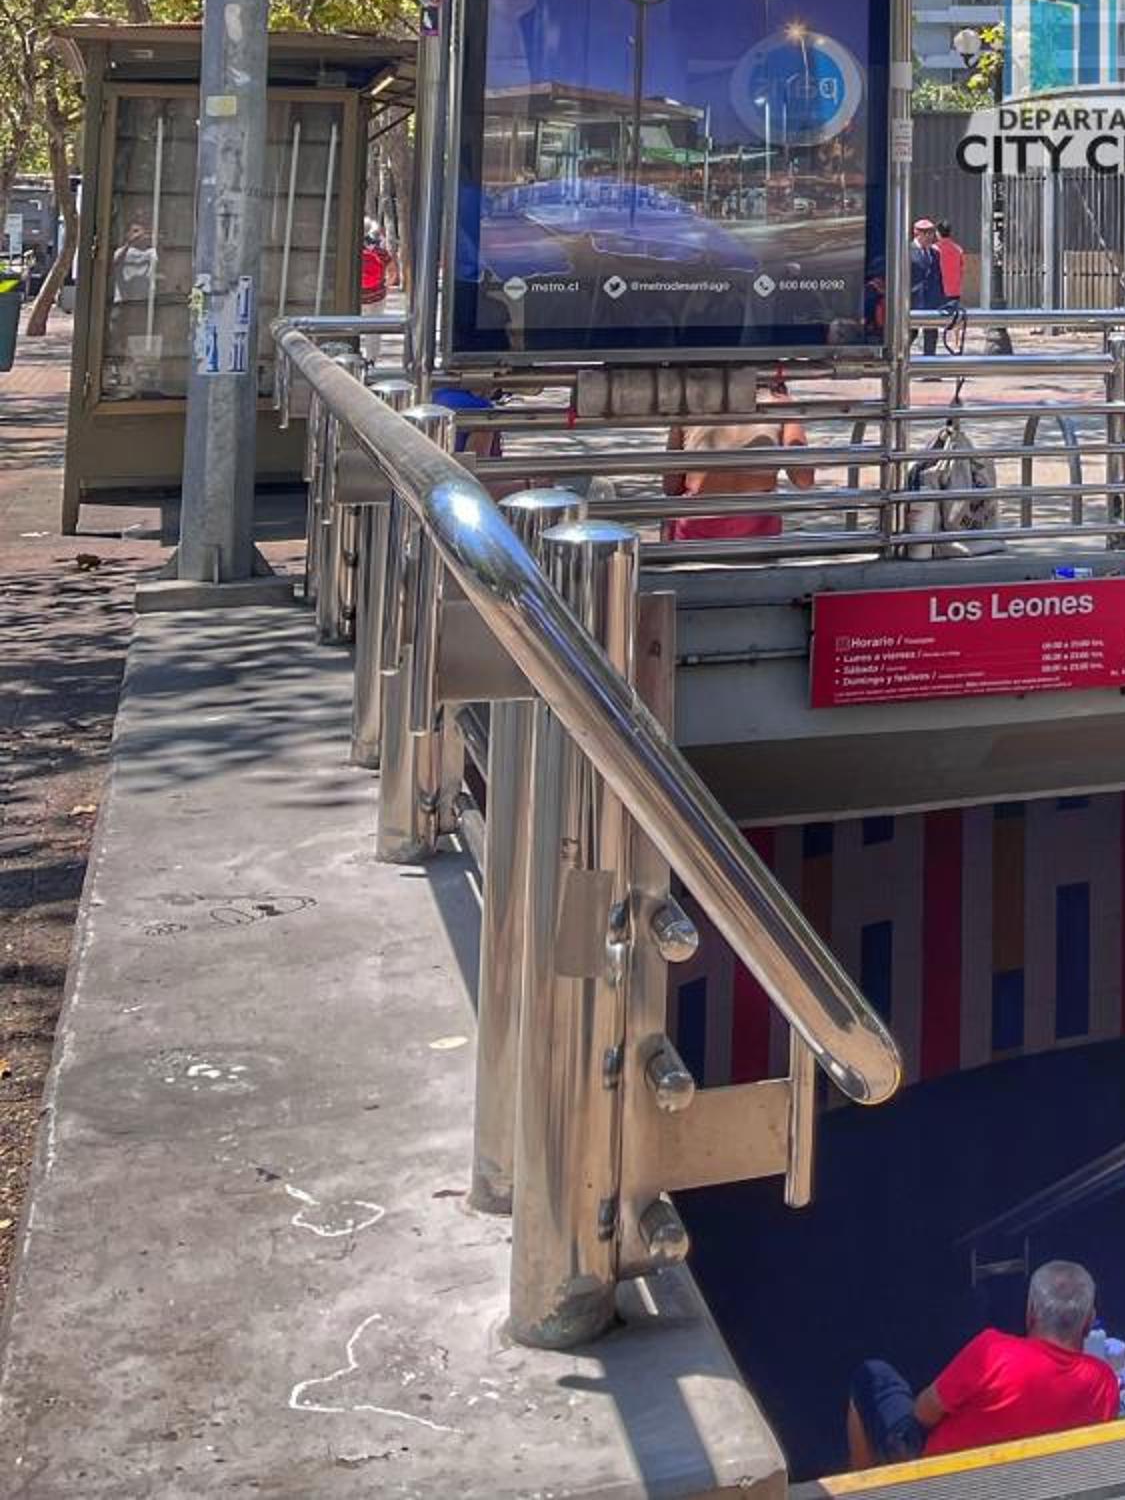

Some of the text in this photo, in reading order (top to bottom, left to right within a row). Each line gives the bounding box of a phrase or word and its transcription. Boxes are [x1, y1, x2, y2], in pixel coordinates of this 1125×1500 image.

[531, 281, 580, 293] metro.cl
[929, 593, 1094, 623] Los Leones
[851, 637, 895, 649] Horario
